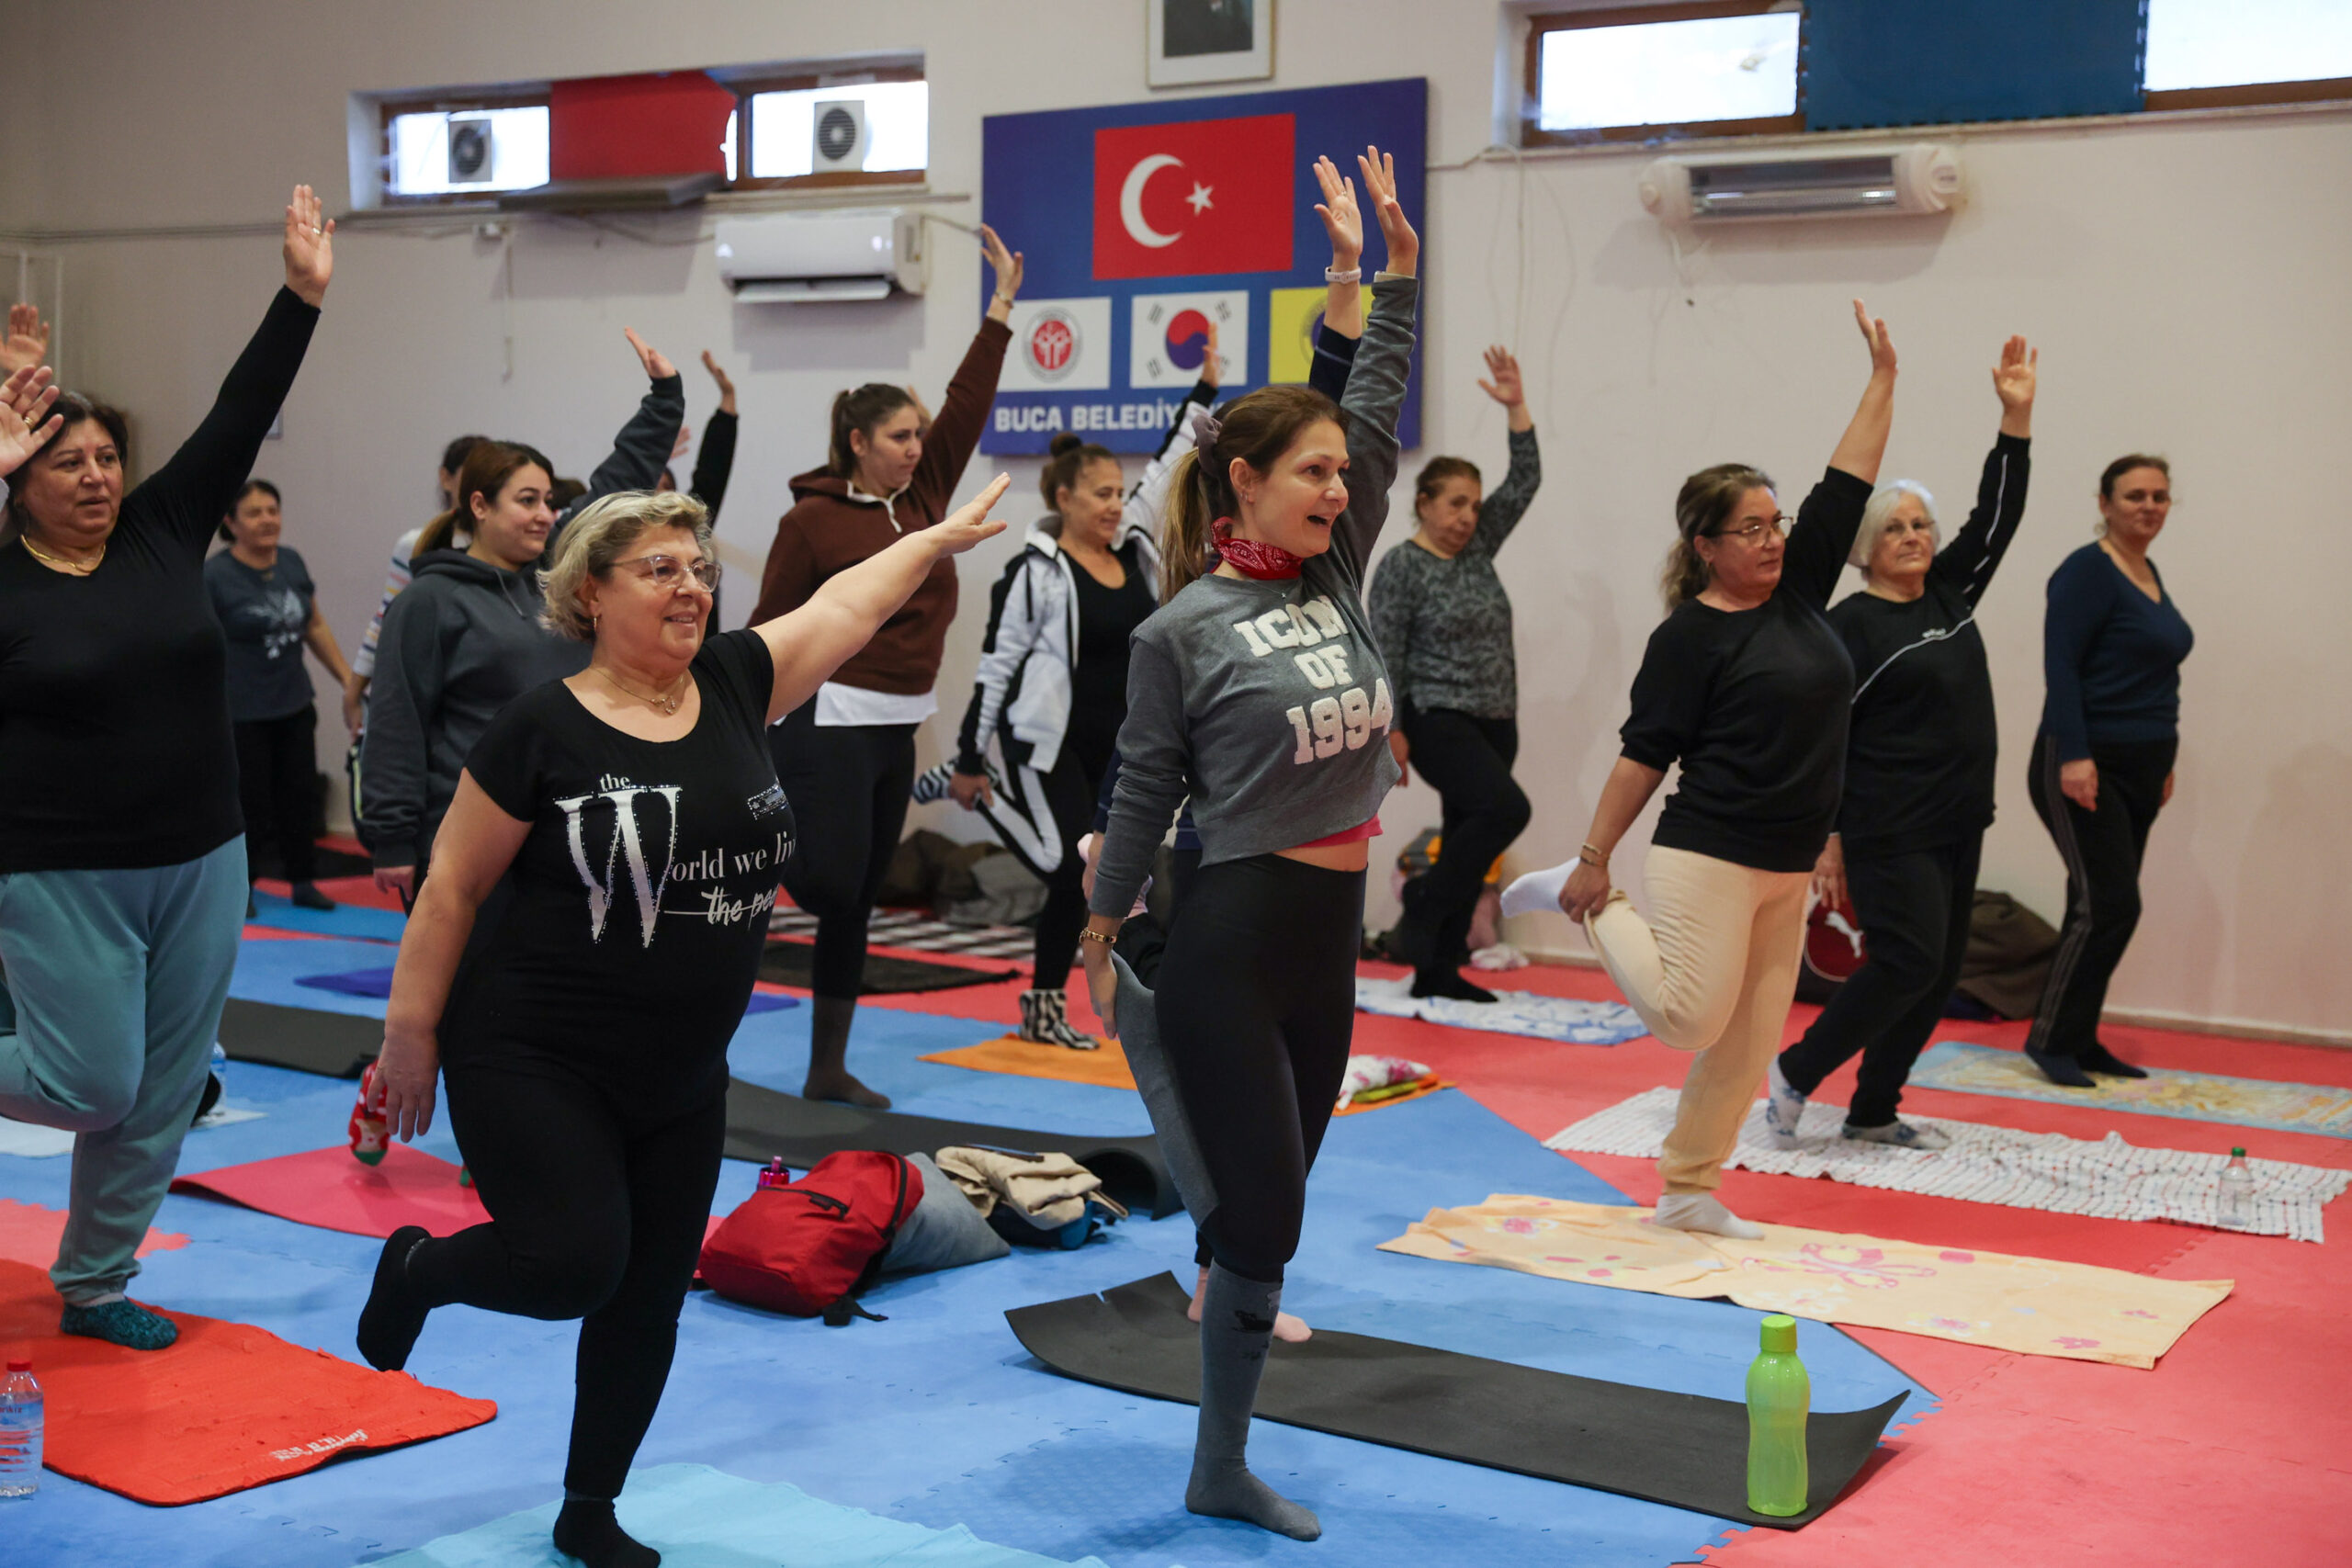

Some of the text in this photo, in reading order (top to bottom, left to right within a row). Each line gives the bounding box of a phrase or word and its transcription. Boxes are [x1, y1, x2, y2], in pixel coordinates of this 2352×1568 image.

[994, 397, 1185, 433] BUCA BELEDİY
[1293, 644, 1353, 690] OF
[1286, 677, 1394, 765] 1994
[599, 773, 631, 791] the
[734, 849, 768, 876] we
[700, 885, 745, 926] the
